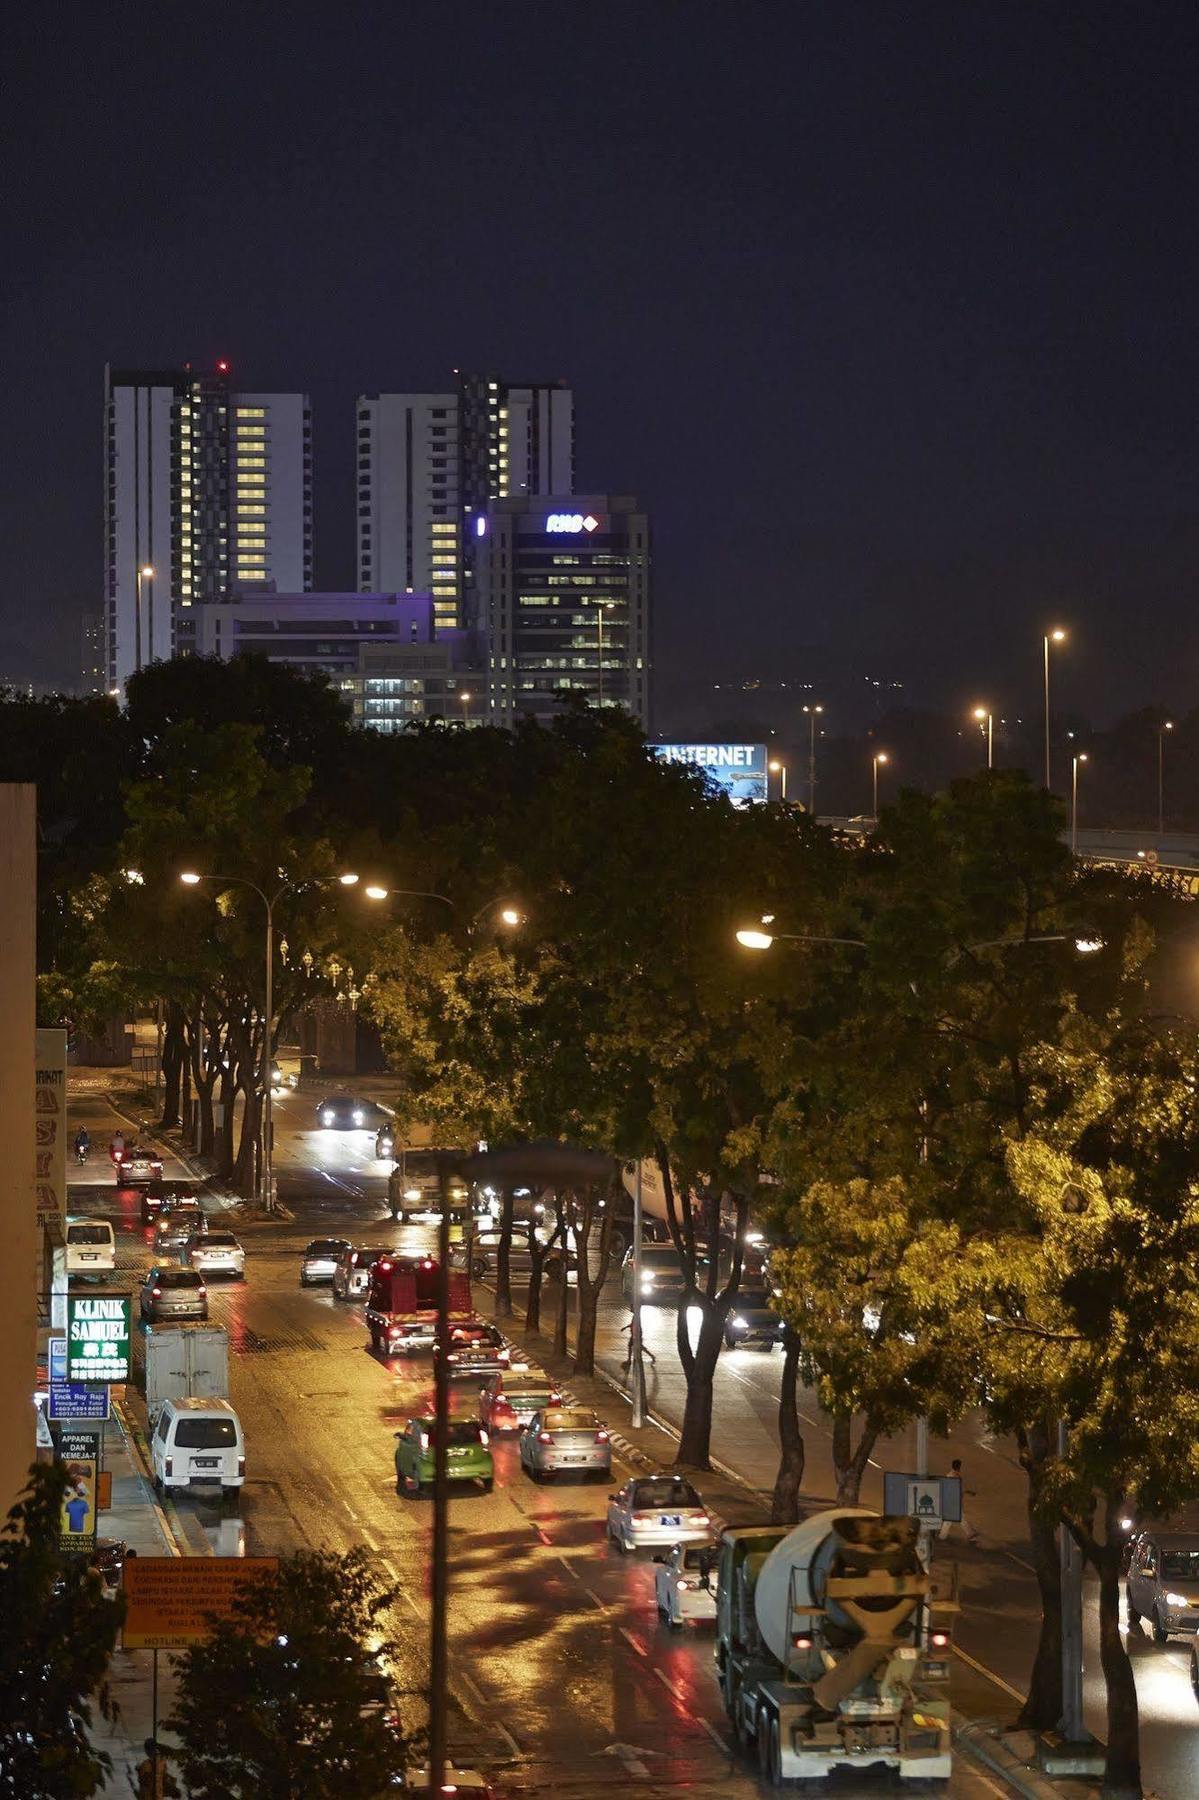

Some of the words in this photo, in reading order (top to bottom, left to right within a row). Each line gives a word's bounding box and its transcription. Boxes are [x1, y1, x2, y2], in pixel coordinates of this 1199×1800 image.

[666, 746, 755, 766] INTERNET
[74, 1300, 125, 1319] KLINIK
[71, 1321, 128, 1341] SAMUEL
[144, 1637, 187, 1645] HOTLINE
